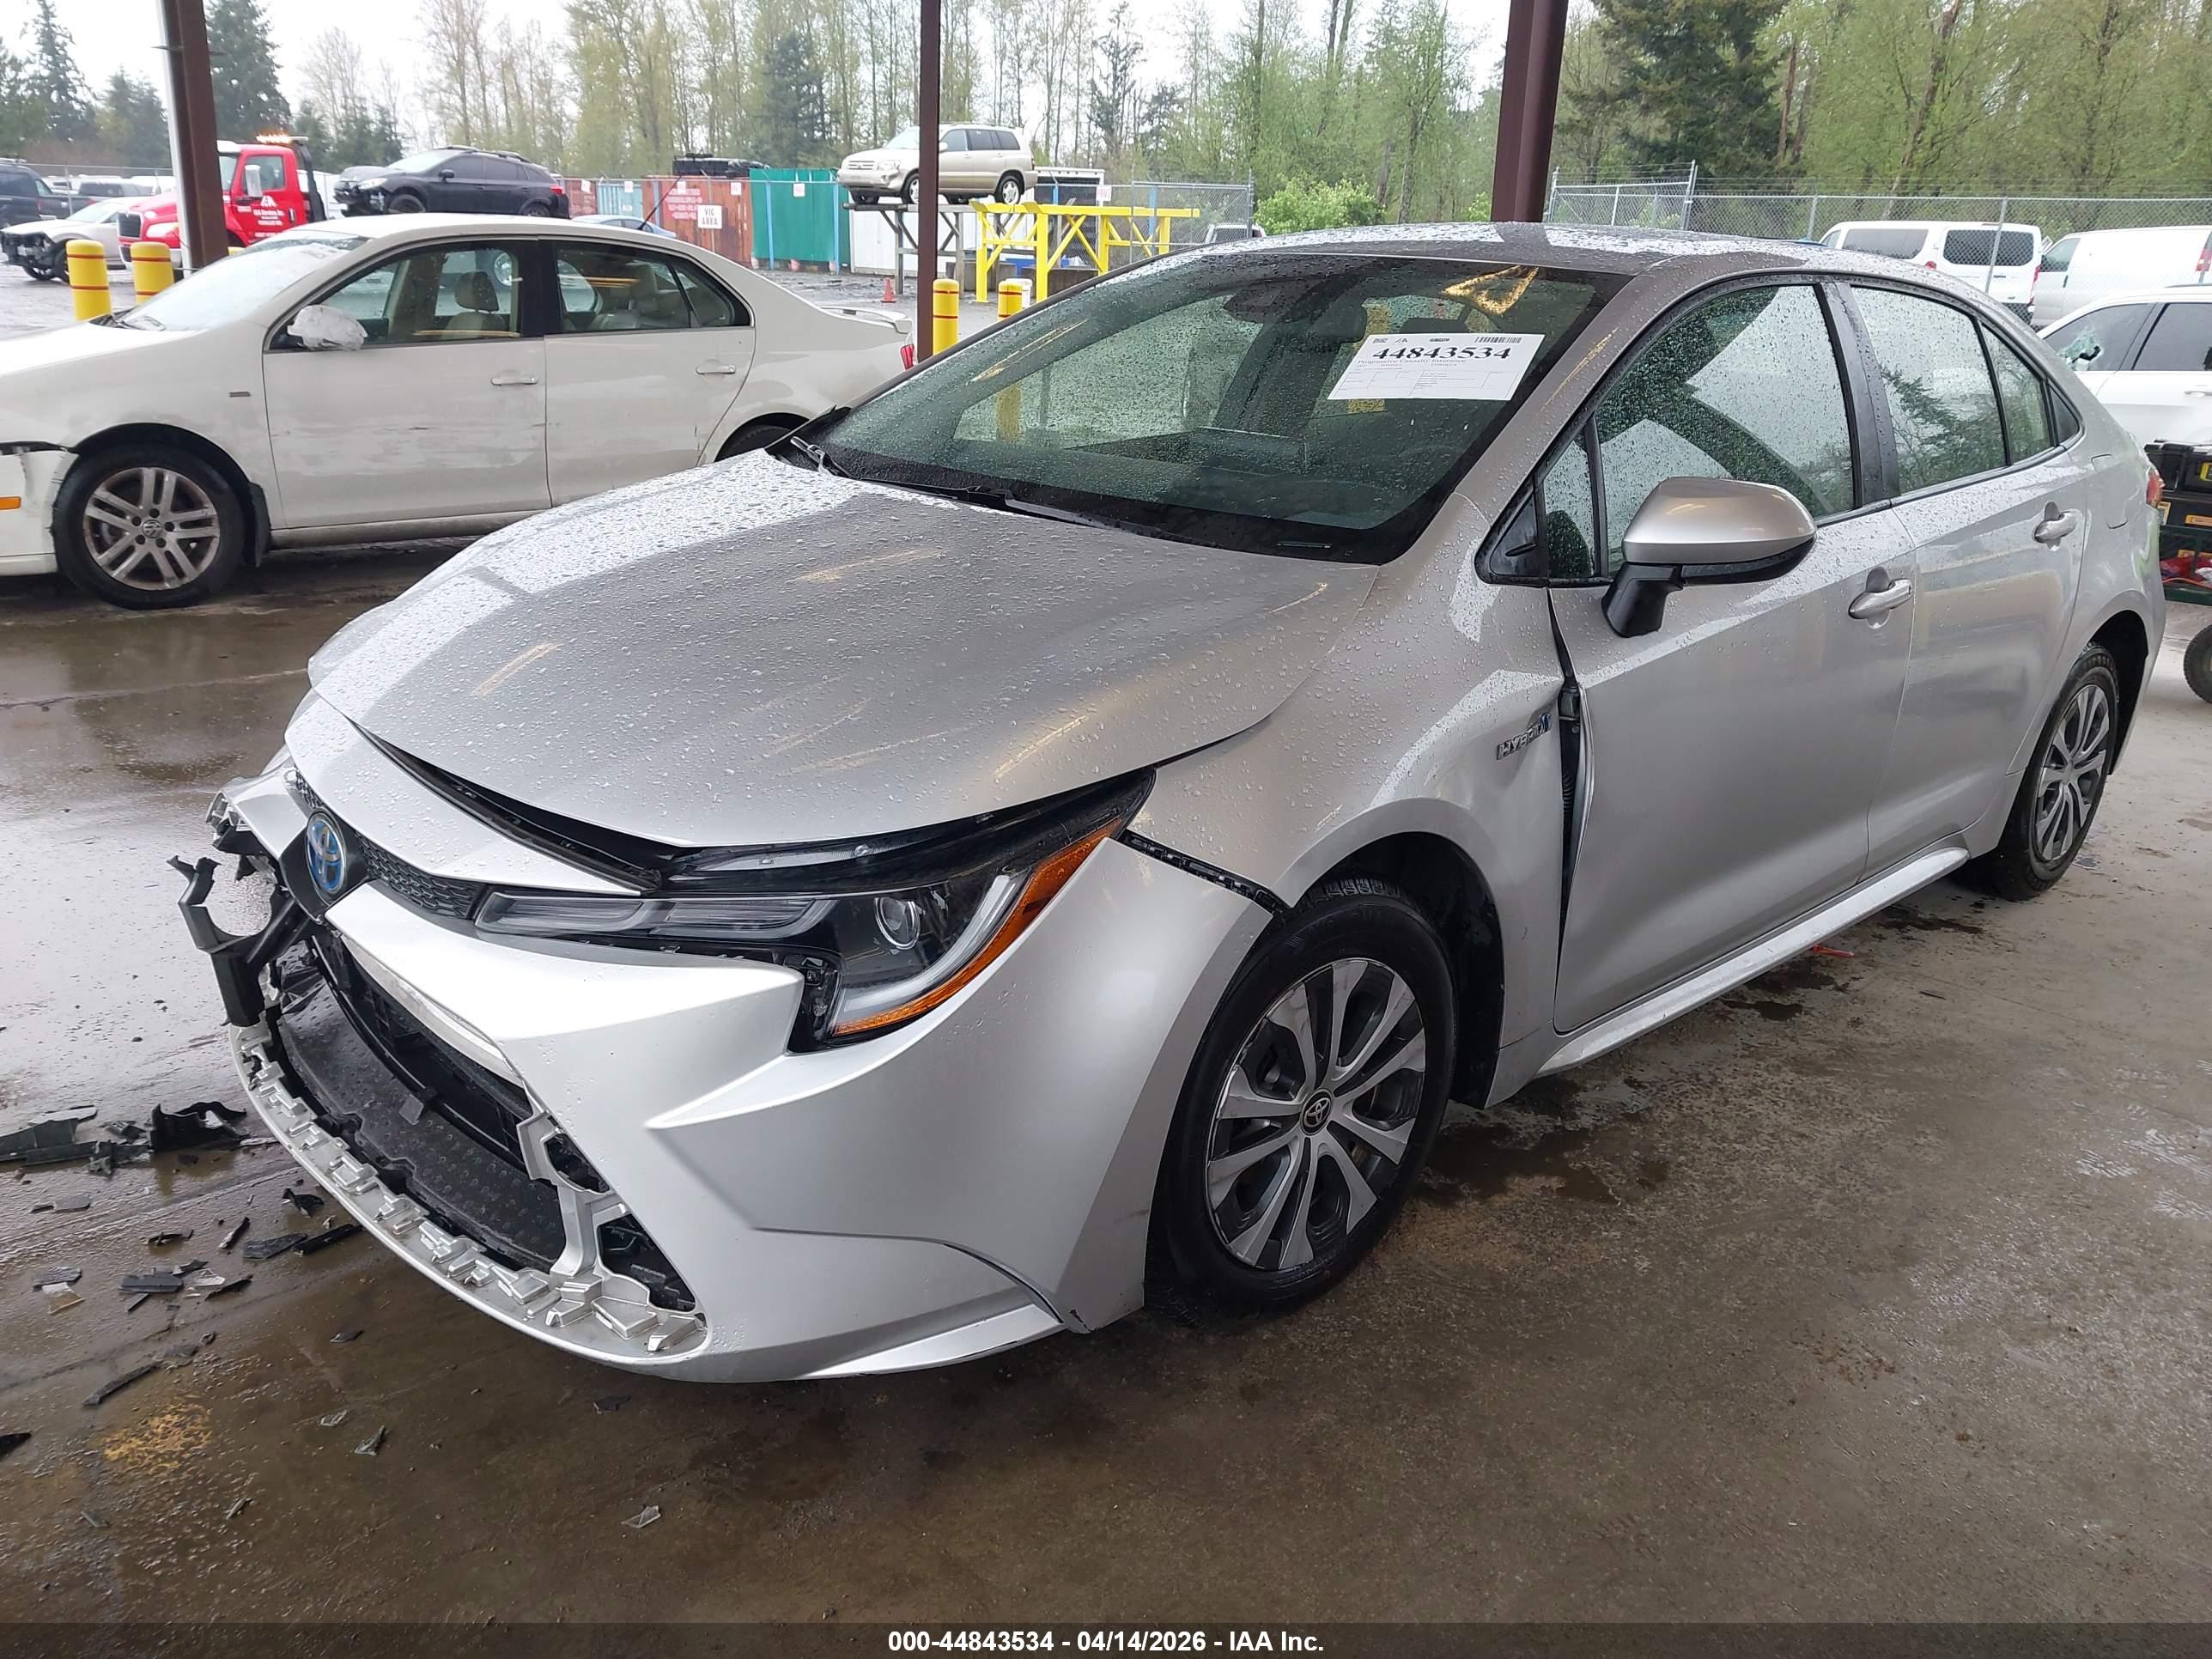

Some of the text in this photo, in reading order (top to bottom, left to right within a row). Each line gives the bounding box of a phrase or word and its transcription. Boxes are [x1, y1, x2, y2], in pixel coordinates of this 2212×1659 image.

[704, 208, 715, 216] VIC
[702, 217, 719, 226] AREA
[1372, 347, 1511, 359] 44843534
